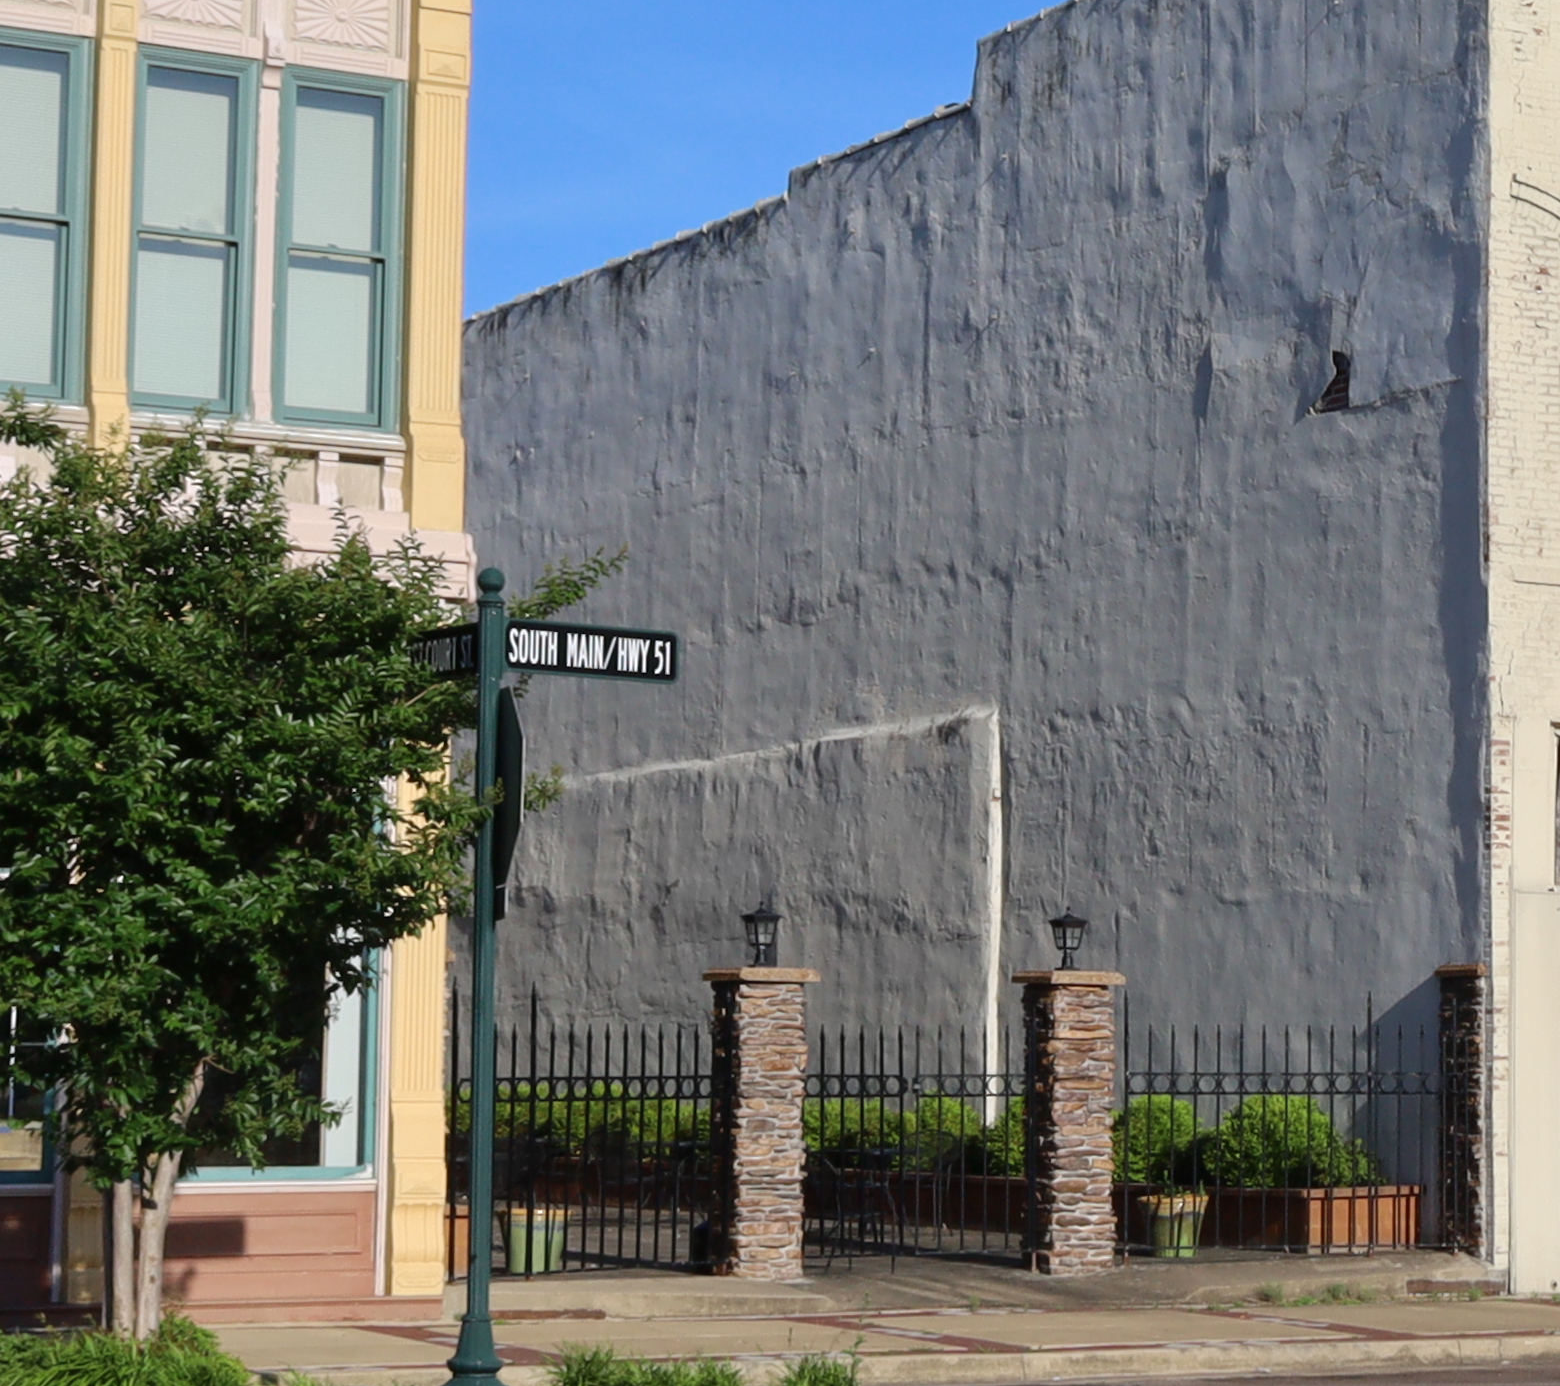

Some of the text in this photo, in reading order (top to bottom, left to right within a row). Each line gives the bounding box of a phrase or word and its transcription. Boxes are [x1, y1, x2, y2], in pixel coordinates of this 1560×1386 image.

[508, 628, 671, 676] SOUTH MAIN/HWY 51
